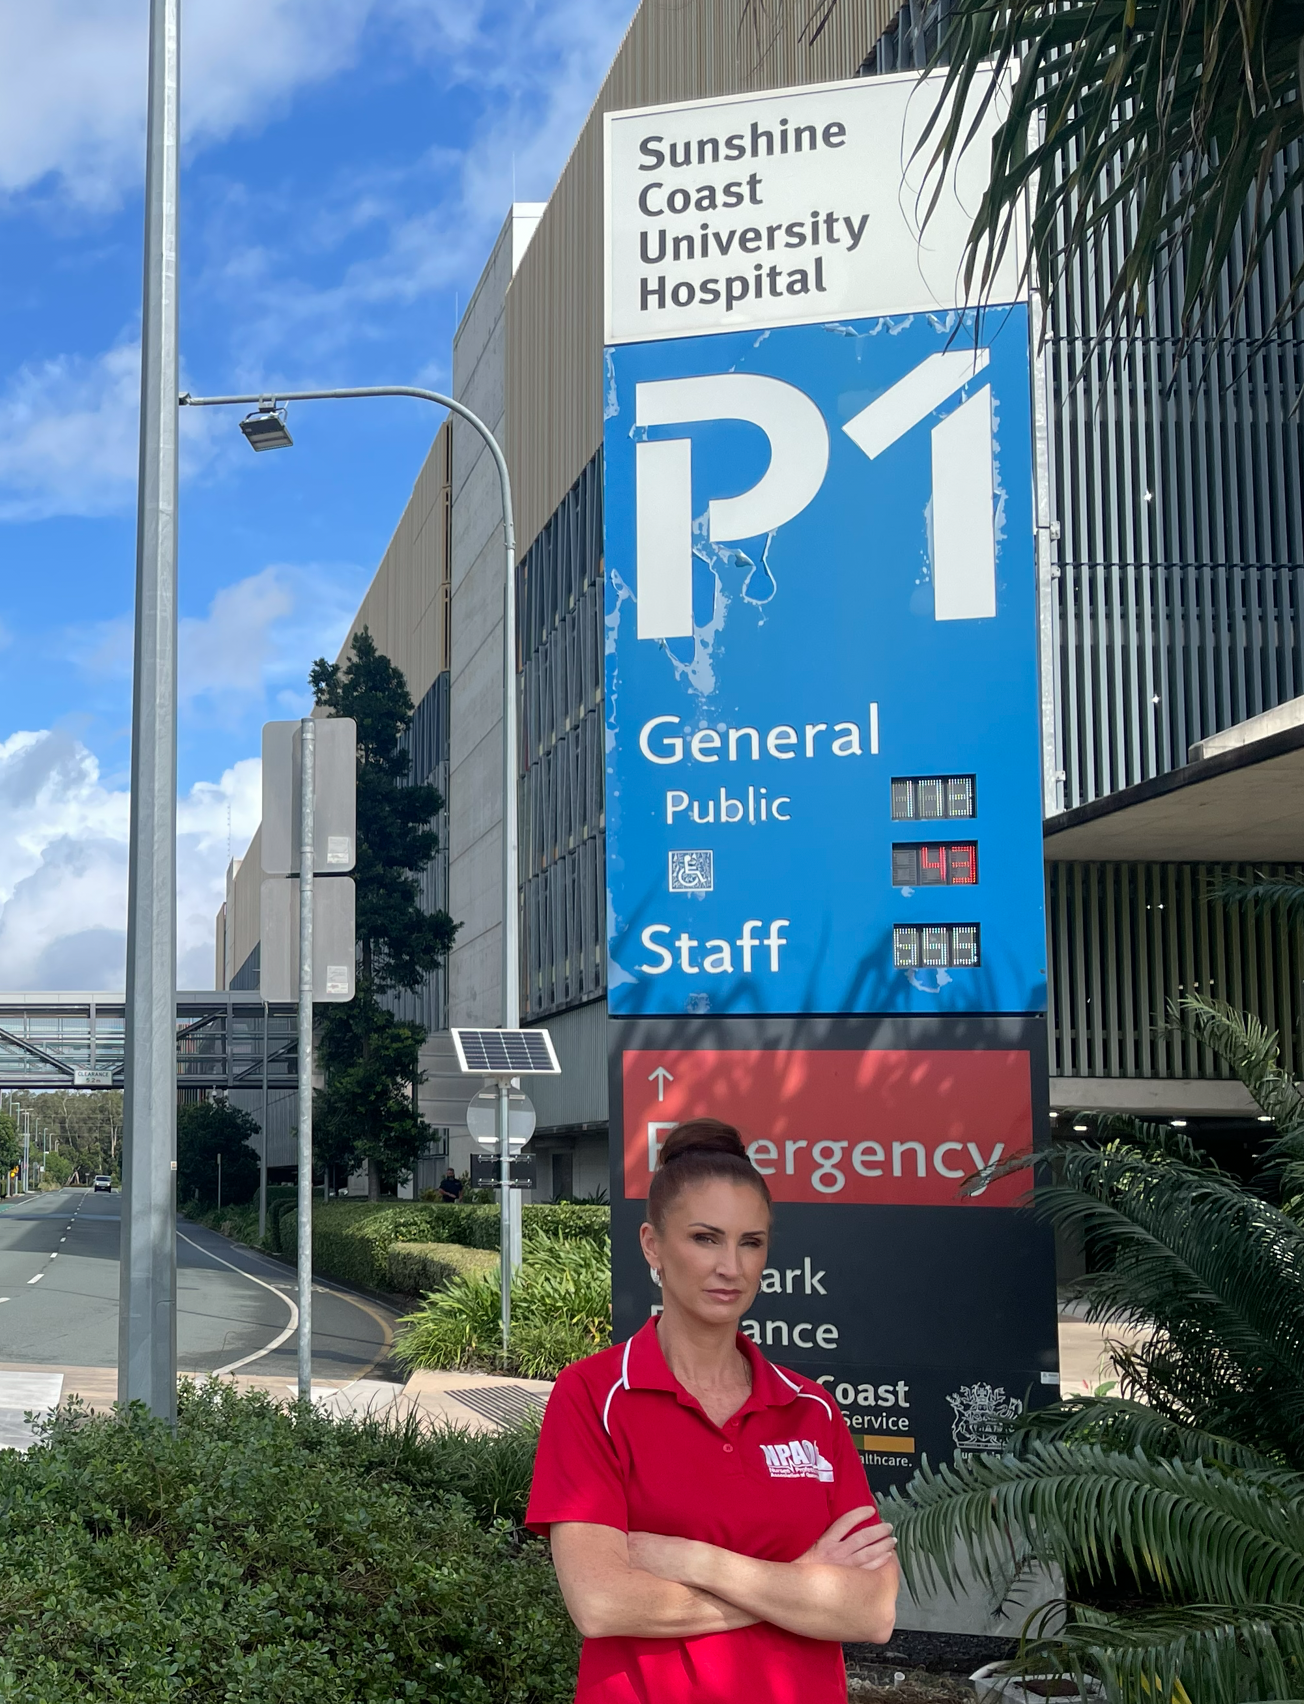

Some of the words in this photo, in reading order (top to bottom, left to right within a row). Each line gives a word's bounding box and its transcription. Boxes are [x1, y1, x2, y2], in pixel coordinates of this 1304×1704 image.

[637, 117, 847, 172] Sunshine
[638, 172, 763, 218] Coast
[639, 210, 870, 265] University
[639, 256, 827, 312] Hospital
[635, 347, 997, 640] P1
[638, 701, 880, 765] General
[666, 785, 792, 825] Public
[921, 845, 976, 884] 43
[640, 919, 791, 975] Staff
[647, 1121, 1005, 1197] Eergency
[761, 1256, 828, 1295] ark
[841, 1410, 910, 1431] Service
